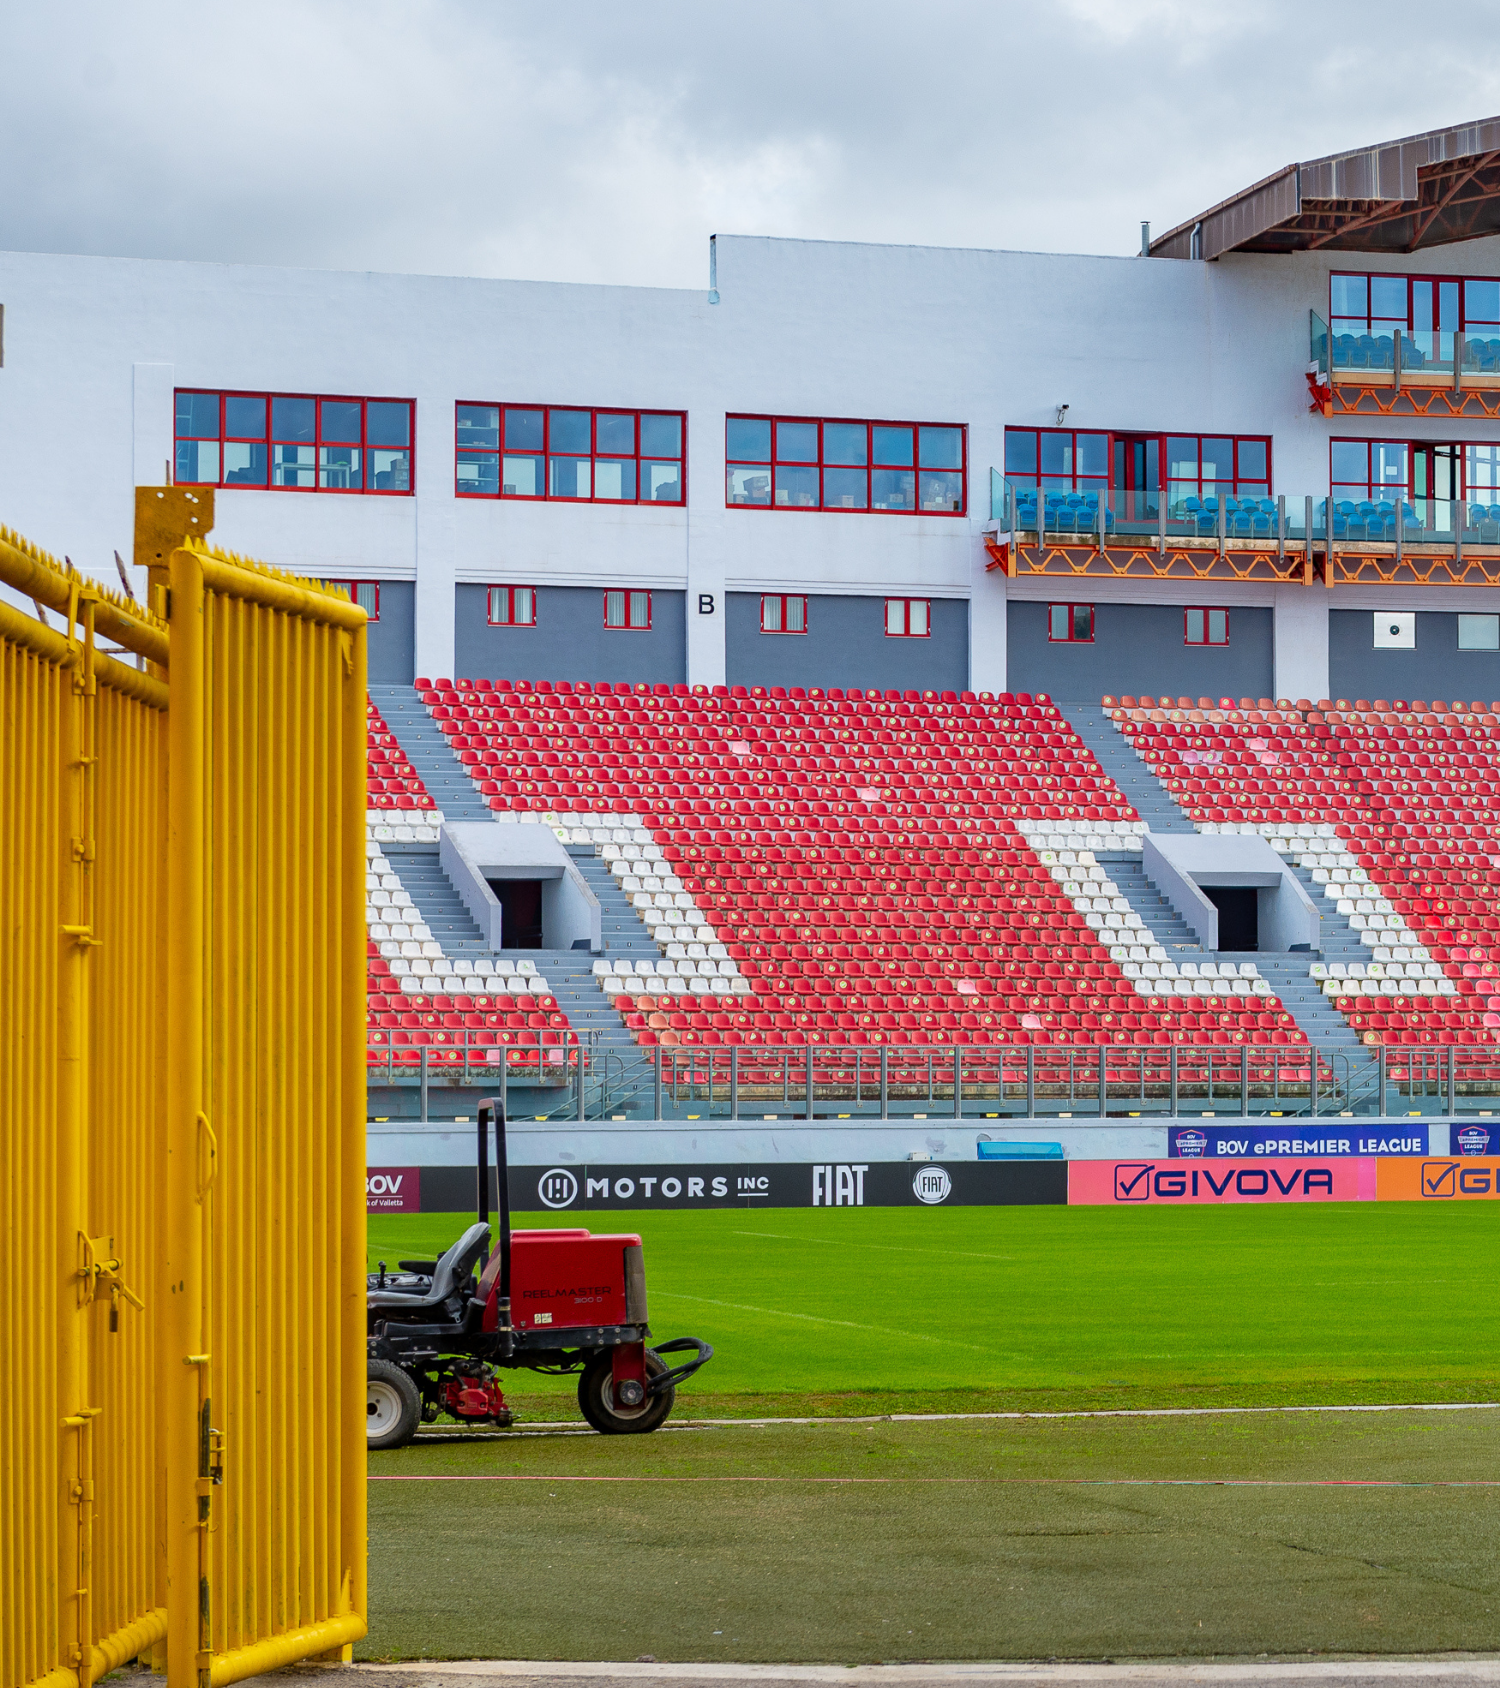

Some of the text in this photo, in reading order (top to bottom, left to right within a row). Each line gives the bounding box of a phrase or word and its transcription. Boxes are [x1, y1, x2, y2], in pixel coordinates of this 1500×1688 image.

[699, 594, 715, 614] B
[1217, 1138, 1422, 1155] BOV ePREMIER LEAGUE
[586, 1176, 769, 1198] MOTORS INC
[812, 1165, 869, 1206] FIAT
[922, 1176, 943, 1192] FIAT
[1154, 1169, 1333, 1197] GIVOVA
[523, 1286, 612, 1299] REELMASTER
